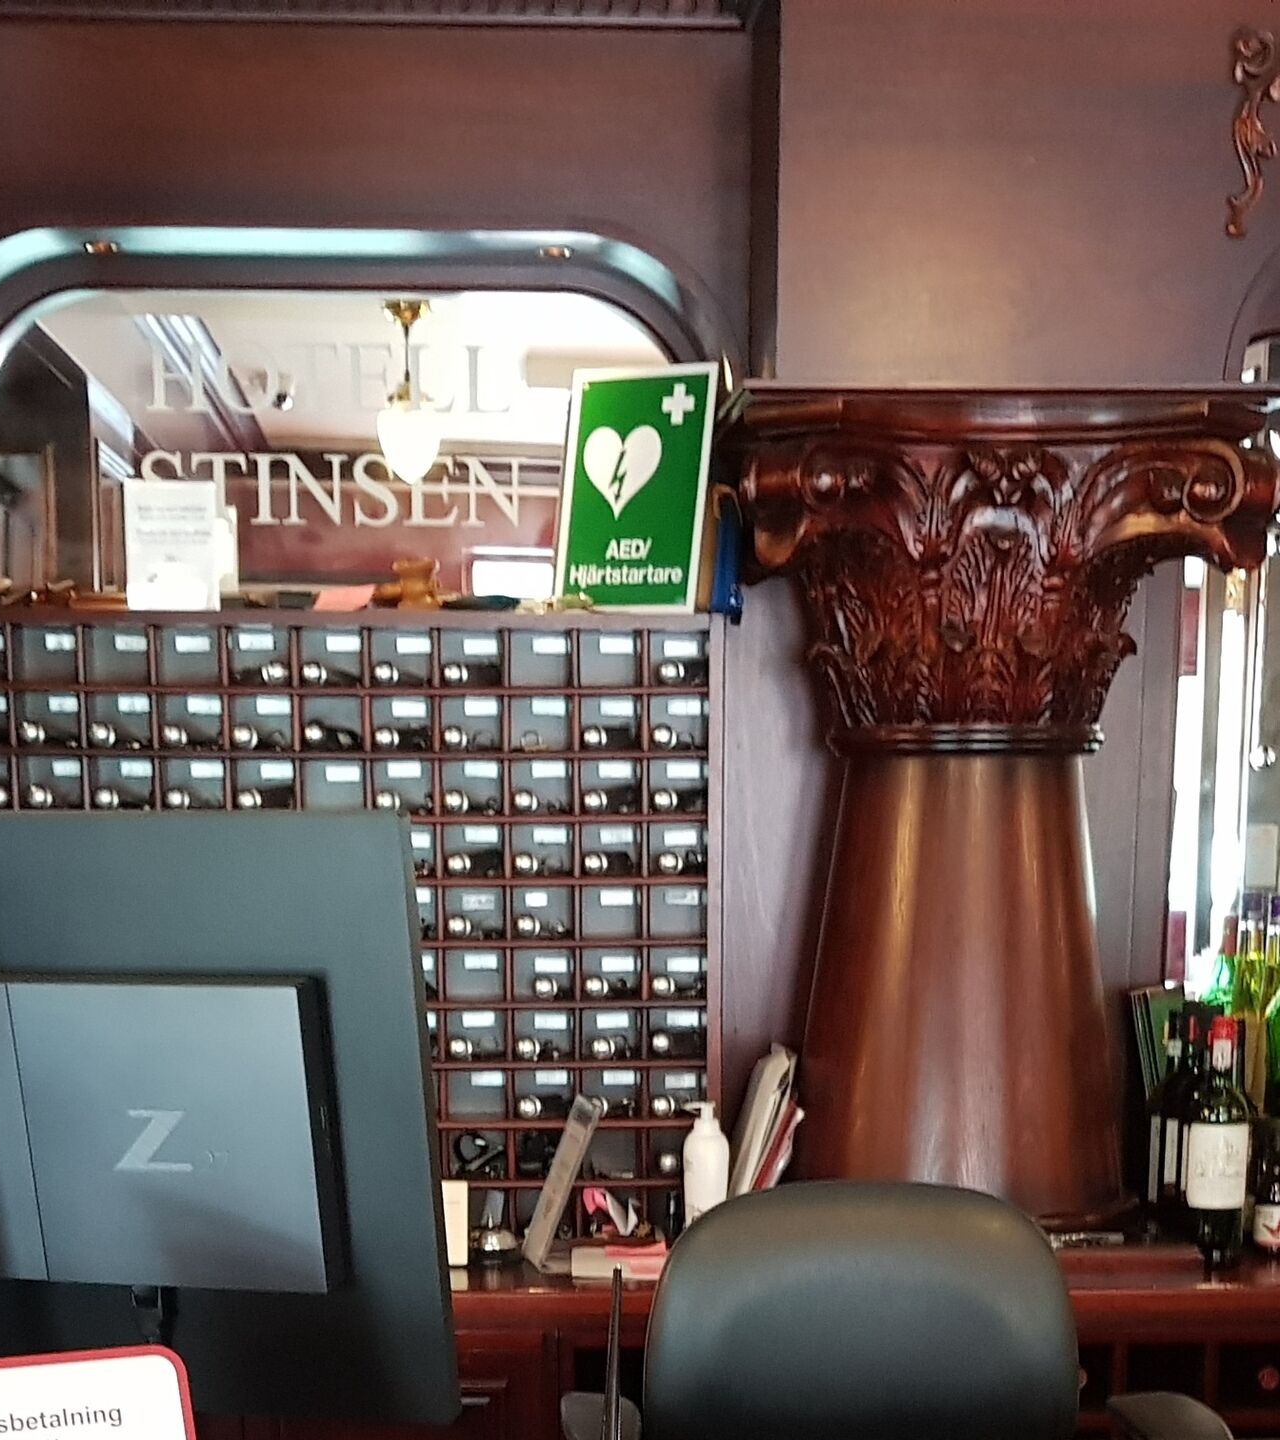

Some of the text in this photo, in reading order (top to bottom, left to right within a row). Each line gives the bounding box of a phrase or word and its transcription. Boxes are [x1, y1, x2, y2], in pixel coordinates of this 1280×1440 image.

[144, 342, 512, 414] HOTELL
[605, 536, 653, 560] AED/
[569, 563, 683, 588] Hjärtstartare
[114, 1109, 194, 1172] Z
